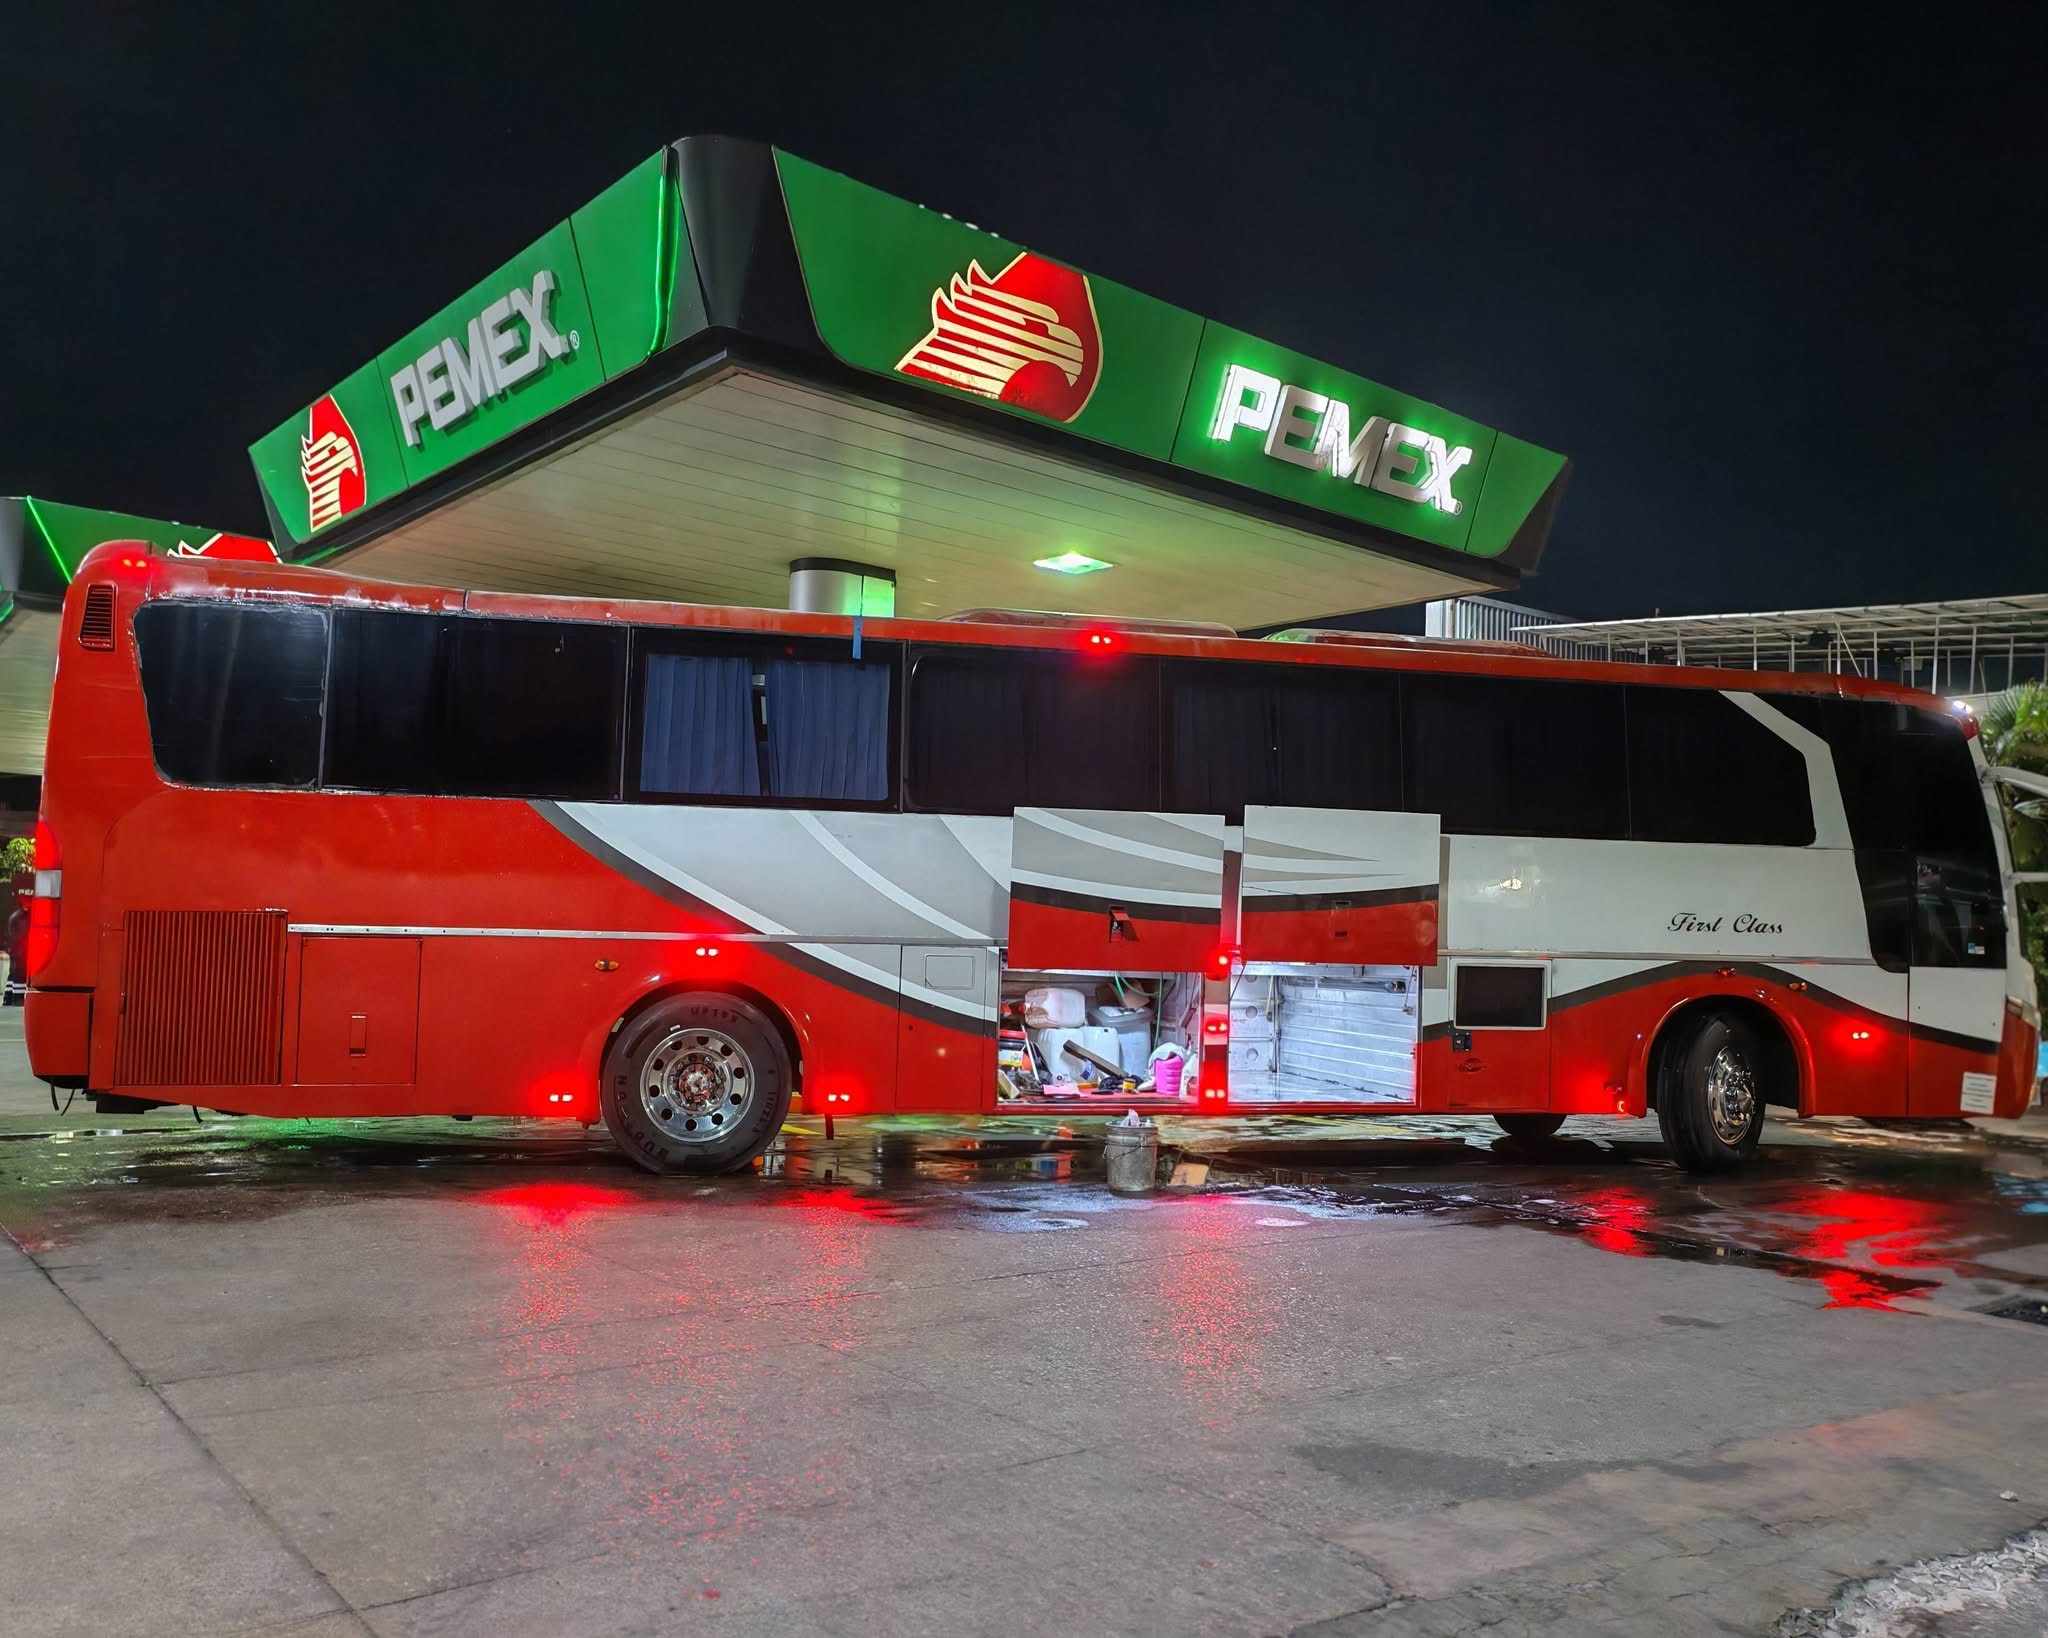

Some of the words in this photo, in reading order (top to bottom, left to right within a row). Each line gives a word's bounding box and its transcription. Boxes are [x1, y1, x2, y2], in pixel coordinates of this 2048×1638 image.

[390, 270, 570, 448] PEMEX
[1209, 363, 1473, 513] PEMEX
[1667, 912, 1723, 932] First
[1732, 913, 1783, 934] Class
